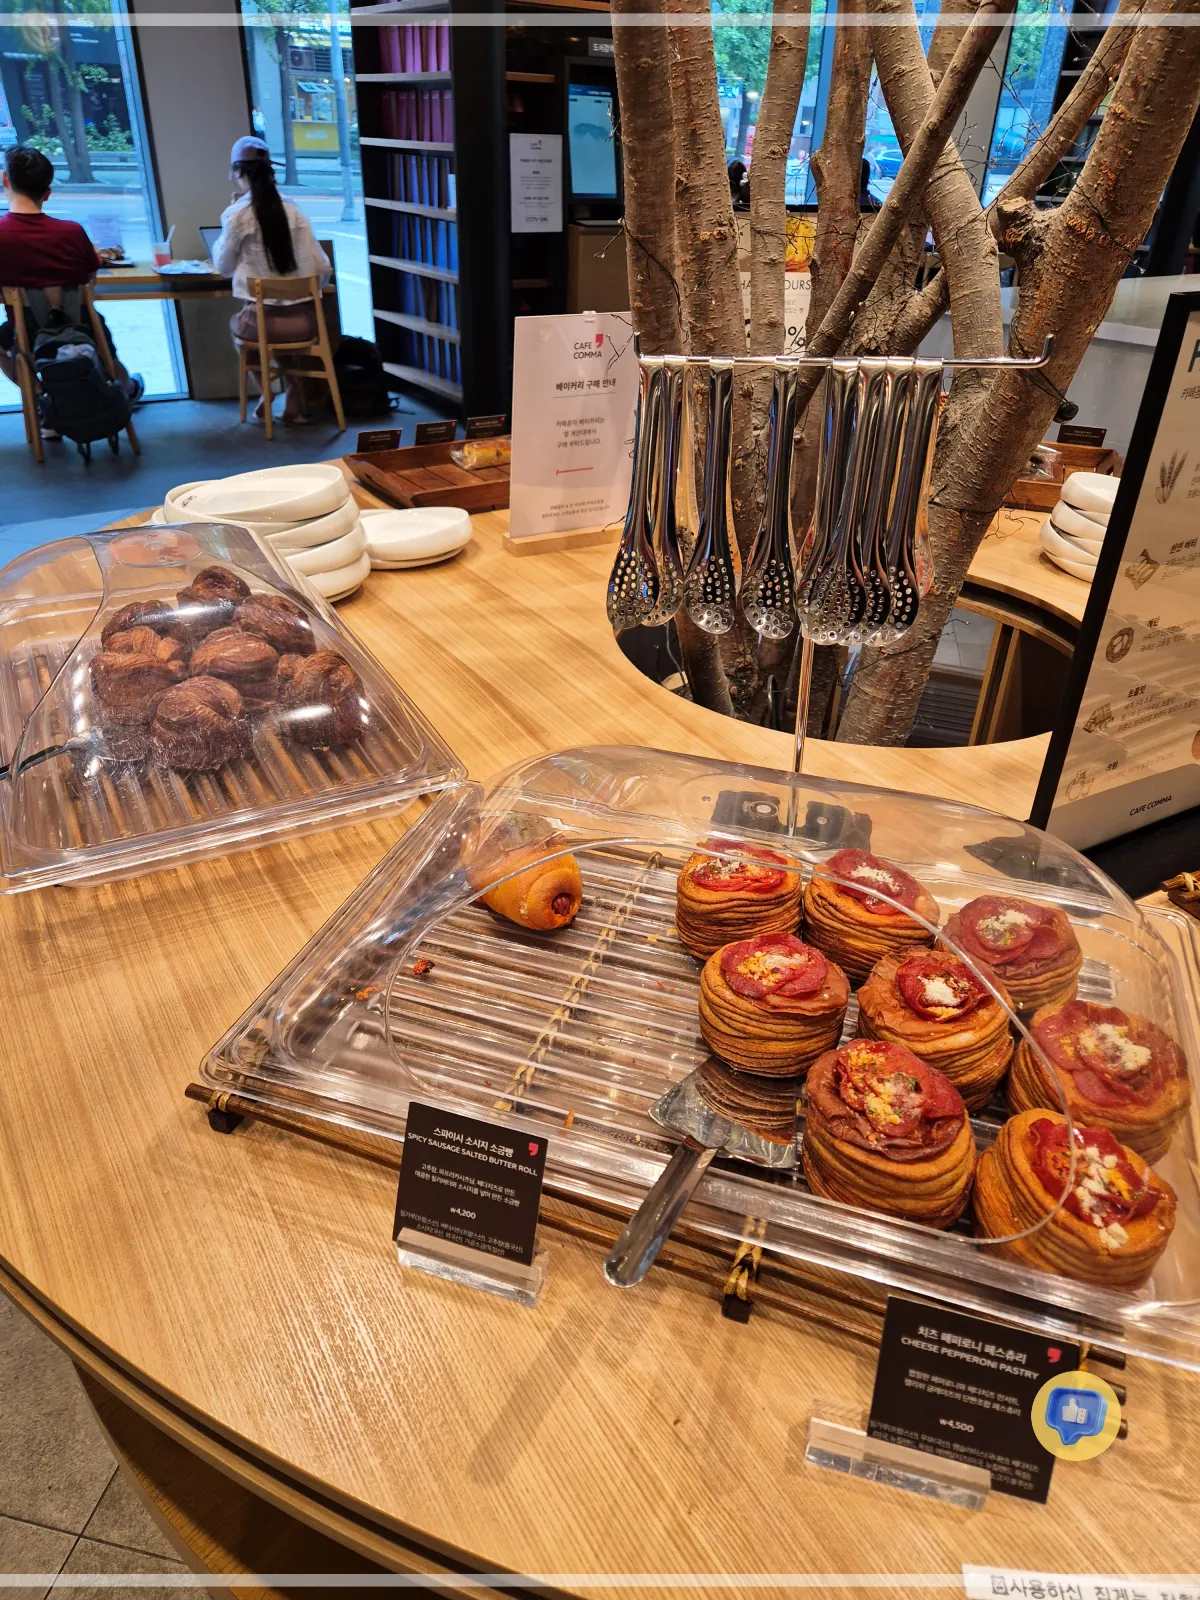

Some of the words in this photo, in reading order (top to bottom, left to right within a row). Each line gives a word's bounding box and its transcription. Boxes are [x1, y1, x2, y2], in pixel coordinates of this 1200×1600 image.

[785, 279, 812, 290] OURS
[573, 341, 593, 350] CAFE
[573, 351, 602, 359] COMMA
[556, 380, 584, 392] 베이커리
[586, 380, 600, 390] 구매
[602, 378, 617, 388] 안내
[1129, 805, 1147, 816] CAFE
[1147, 795, 1173, 810] COMMA
[433, 1127, 464, 1144] 스파이시
[465, 1136, 489, 1150] 소시지
[490, 1144, 514, 1158] 소금빵
[407, 1132, 428, 1144] SPICY
[428, 1138, 461, 1154] SAUSAGE
[461, 1148, 488, 1162] SALTED
[489, 1156, 518, 1170] BUTTER
[518, 1164, 538, 1177] ROLL
[918, 1325, 939, 1340] 치즈
[901, 1337, 940, 1354] CHEESE
[940, 1346, 999, 1369] PEPPERONI
[999, 1361, 1040, 1380] PASTRY
[1011, 1579, 1083, 1600] 사용하신
